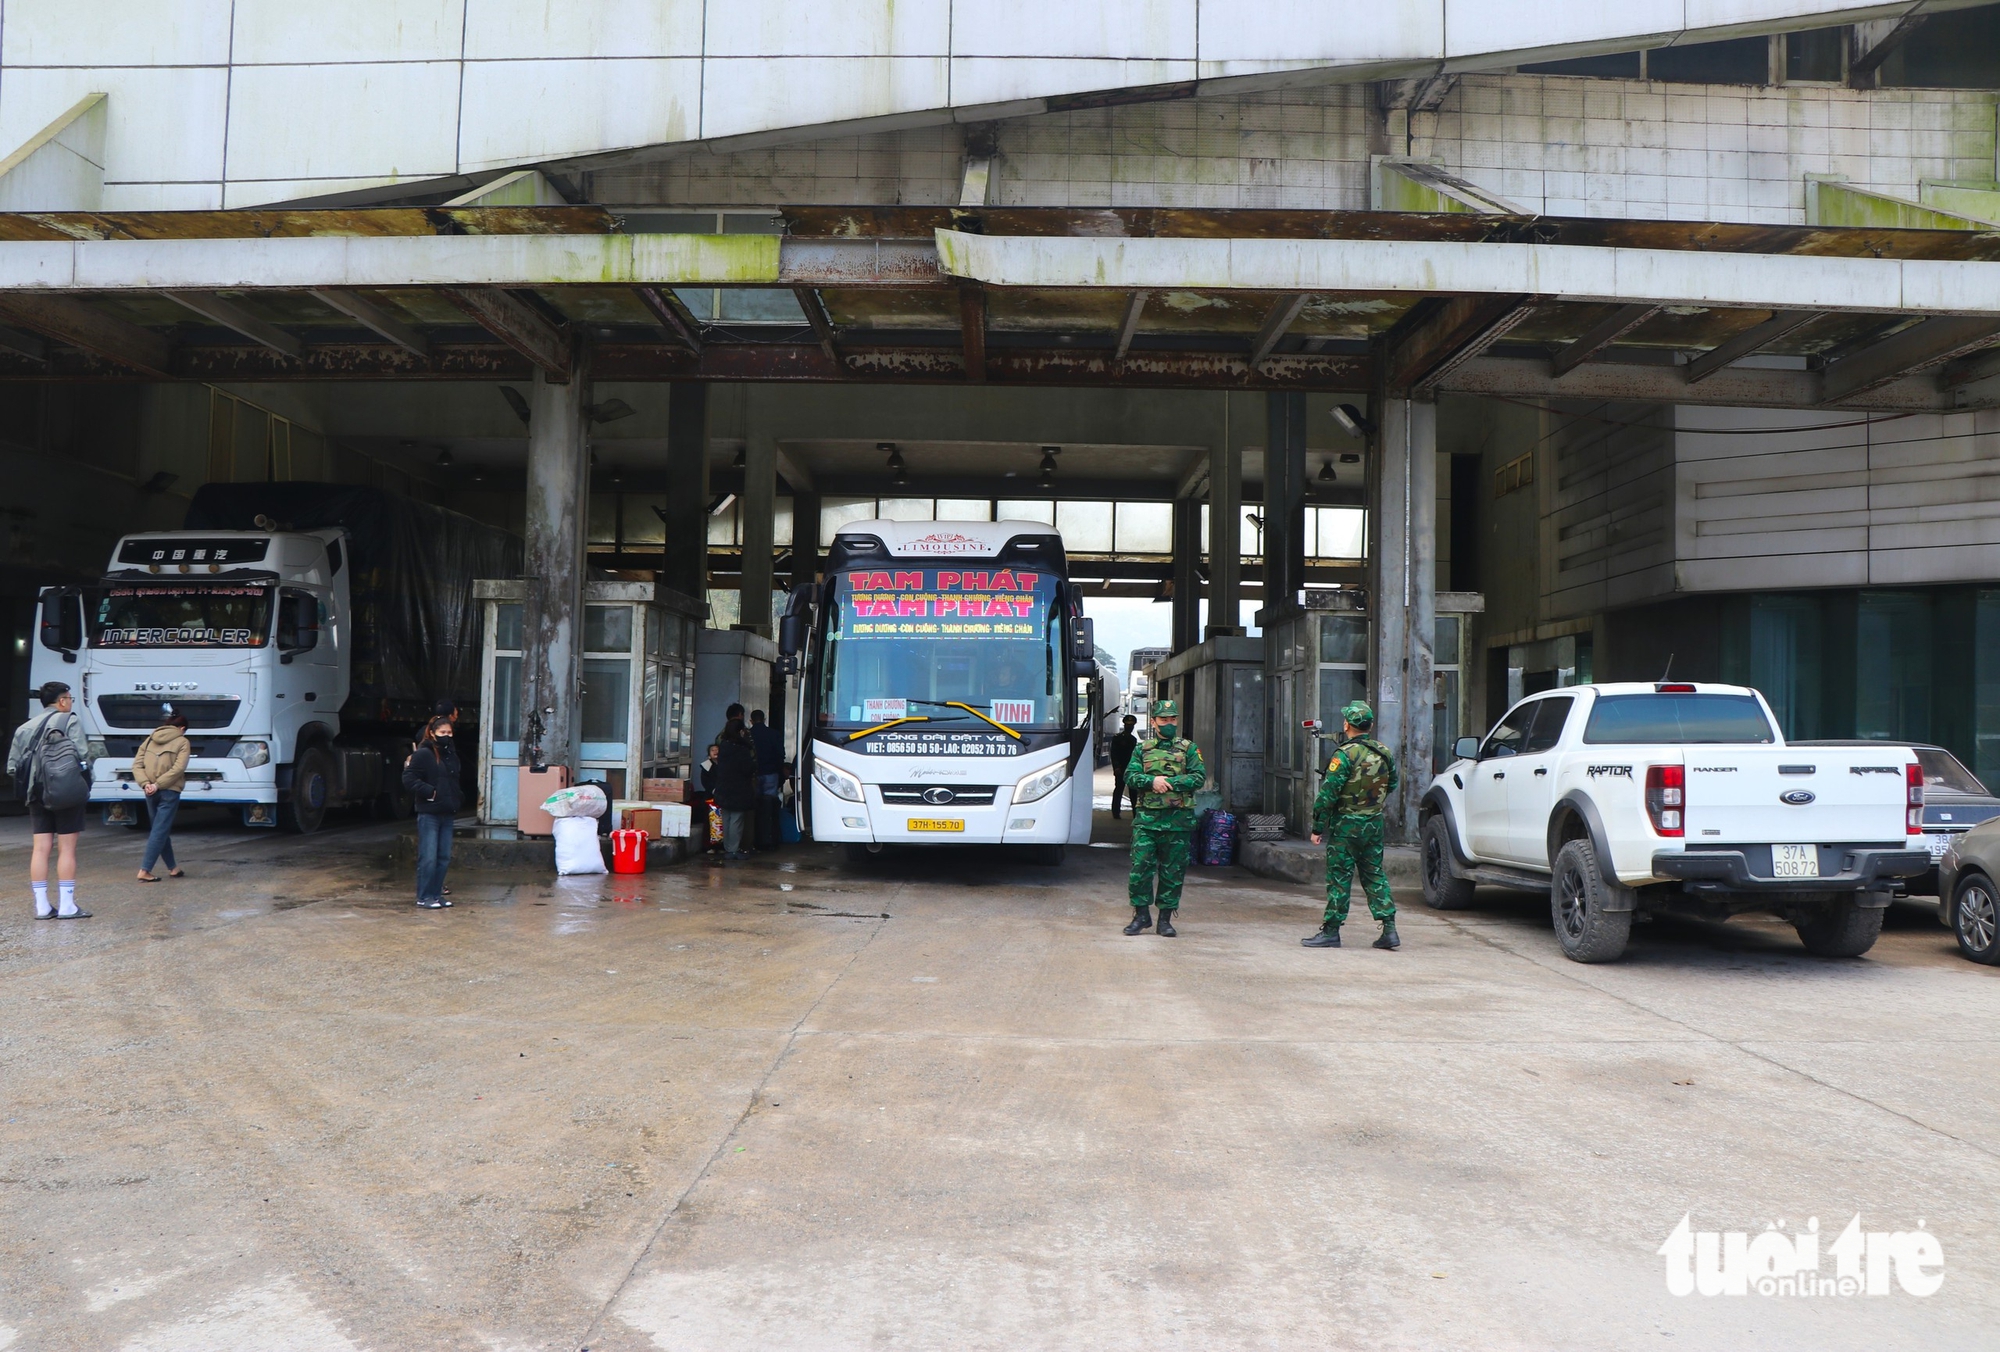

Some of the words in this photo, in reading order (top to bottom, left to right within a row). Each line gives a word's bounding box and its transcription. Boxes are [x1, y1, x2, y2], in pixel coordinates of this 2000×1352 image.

[152, 549, 229, 560] 中国重汽
[903, 543, 987, 551] LIMOUSINE
[849, 572, 923, 590] TAM
[937, 568, 1038, 591] PHÁT
[103, 628, 251, 645] INTERCOOLER
[134, 681, 199, 691] HOWO
[995, 702, 1031, 723] VINH
[877, 732, 918, 741] TỔNG
[922, 733, 946, 741] ĐÀI
[951, 733, 982, 742] ĐẶT
[986, 744, 995, 755] 76
[997, 744, 1006, 755] 76
[1007, 744, 1017, 755] 76
[1587, 766, 1634, 781] RAPTOR
[1782, 845, 1807, 860] 37A
[1775, 860, 1817, 876] 508.72
